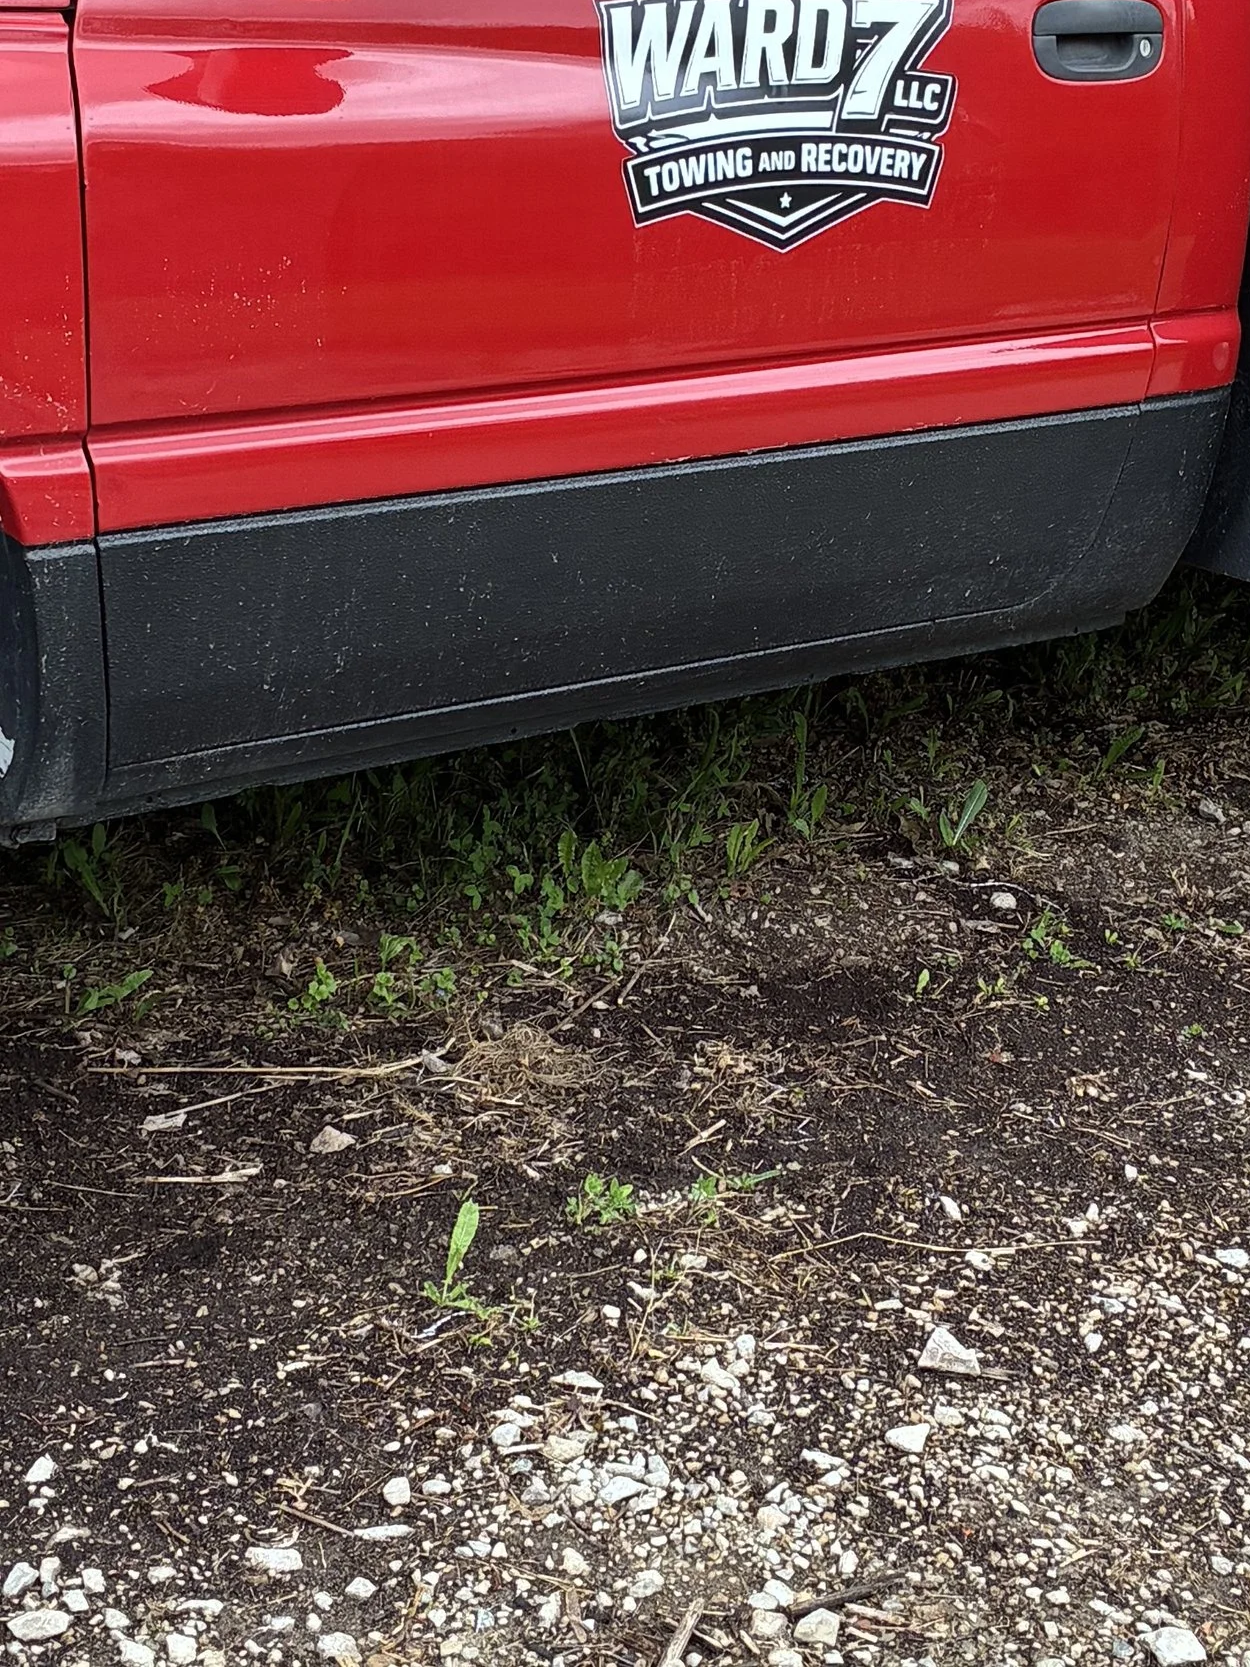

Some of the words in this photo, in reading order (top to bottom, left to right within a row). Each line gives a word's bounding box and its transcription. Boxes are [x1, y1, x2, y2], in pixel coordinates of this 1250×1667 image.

[893, 79, 942, 111] LLC
[643, 147, 753, 197] TOWING
[758, 150, 796, 172] AND
[800, 142, 928, 181] RECOVERY
